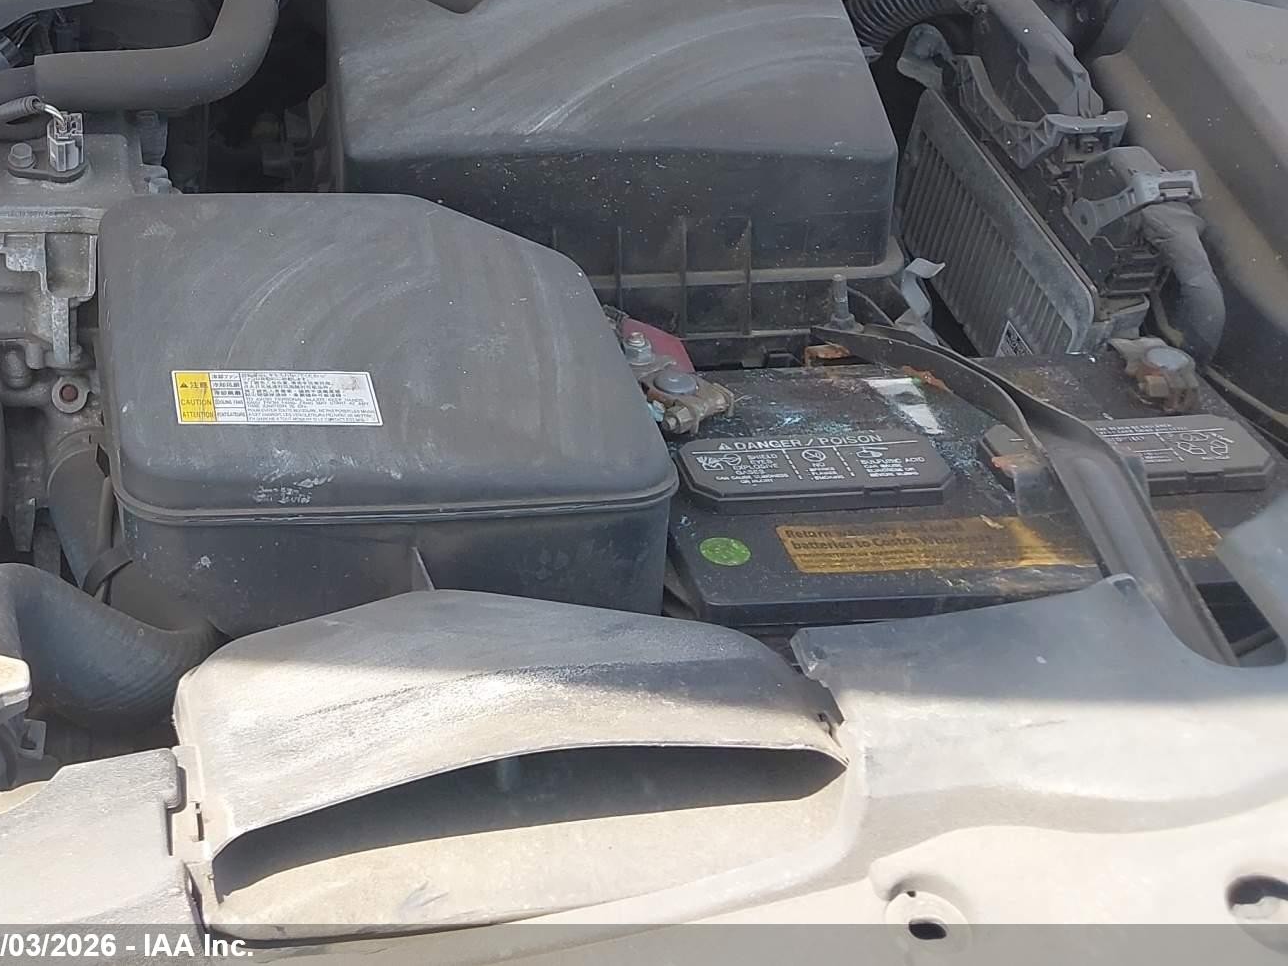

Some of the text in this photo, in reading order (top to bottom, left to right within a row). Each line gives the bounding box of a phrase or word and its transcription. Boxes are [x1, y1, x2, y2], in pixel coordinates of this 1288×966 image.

[180, 398, 212, 406] CAUTION
[182, 410, 214, 419] ATTENTION
[734, 439, 802, 450] DANGER
[818, 434, 883, 446] POISON
[785, 529, 832, 539] Return
[792, 539, 855, 550] batteries
[856, 539, 870, 548] to
